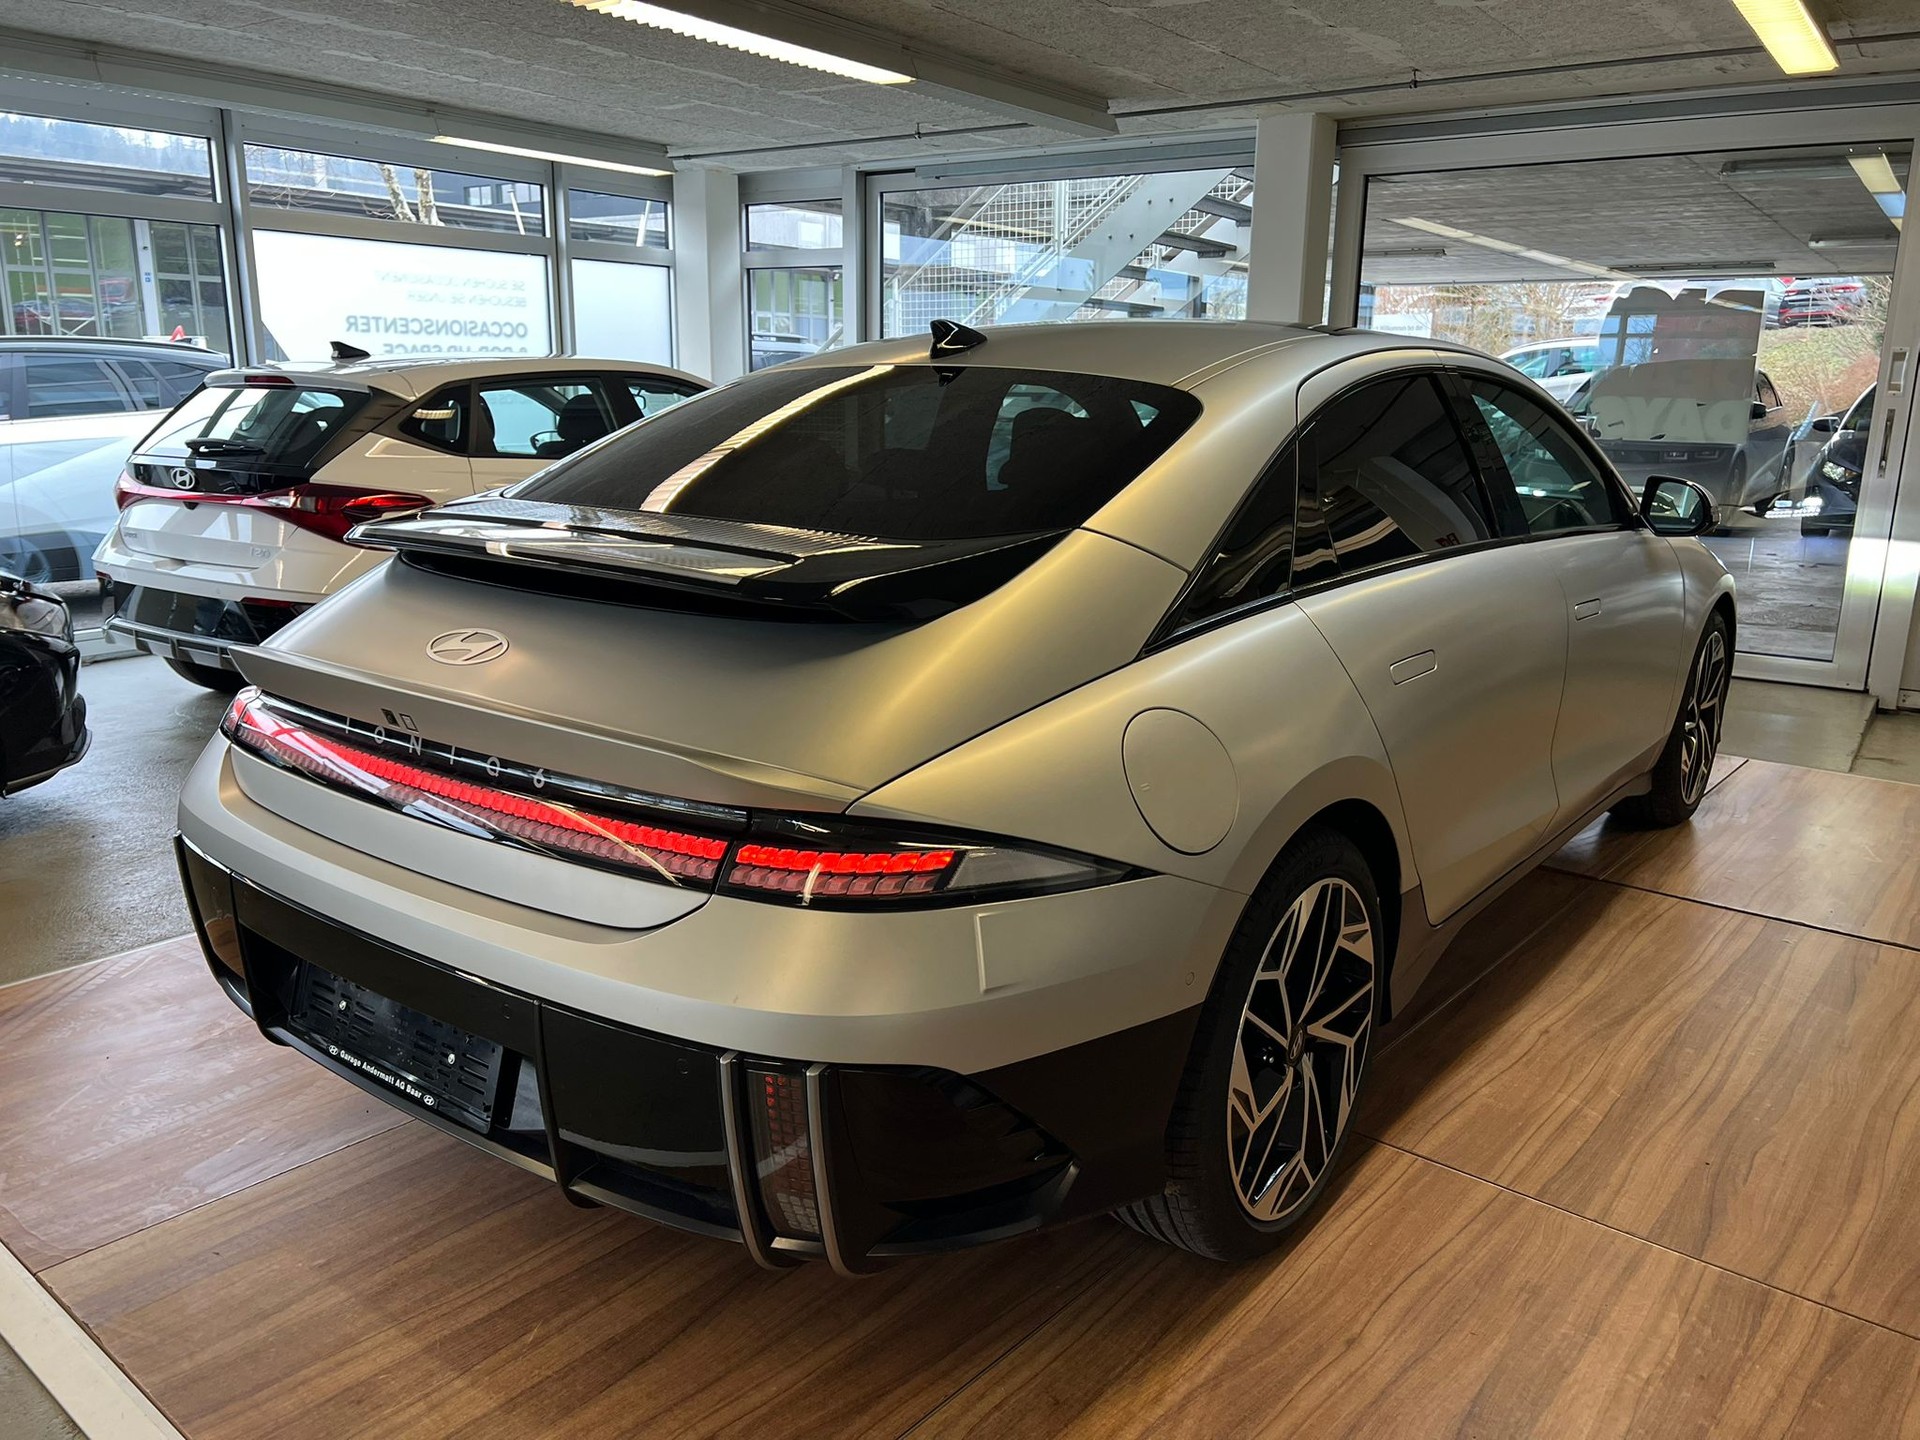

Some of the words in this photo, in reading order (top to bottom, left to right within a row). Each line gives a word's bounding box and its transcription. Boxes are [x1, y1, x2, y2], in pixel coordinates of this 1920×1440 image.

[345, 716, 501, 777] IONIQ
[340, 1050, 362, 1067] Garage
[362, 1062, 395, 1085] Andermatt
[395, 1079, 406, 1091] AG
[406, 1084, 422, 1099] Baar
